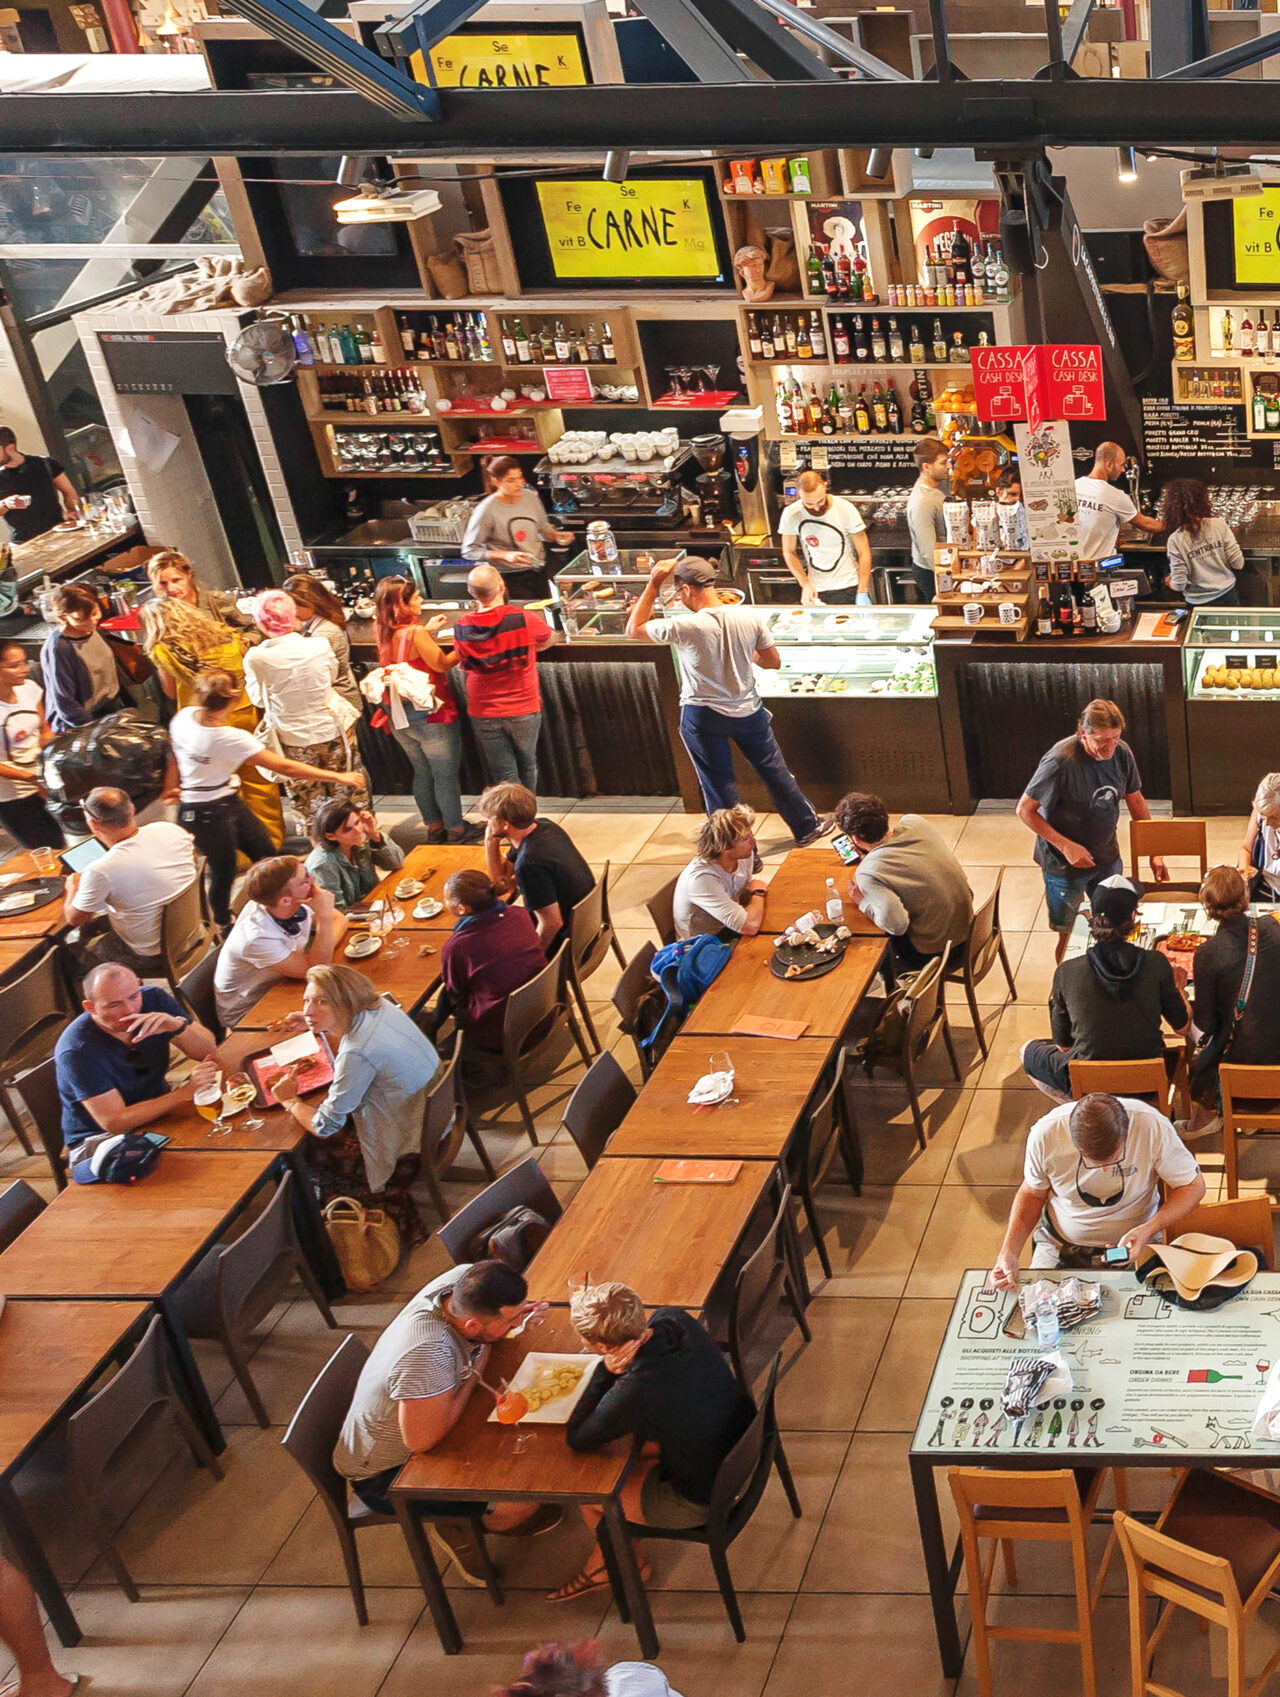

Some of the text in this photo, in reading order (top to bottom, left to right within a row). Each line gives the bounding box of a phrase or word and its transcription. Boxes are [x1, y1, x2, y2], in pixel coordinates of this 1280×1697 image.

[492, 41, 508, 52] Se
[437, 57, 453, 68] Fe
[557, 56, 564, 66] K
[460, 62, 551, 87] CARNE
[620, 186, 636, 197] Se
[566, 201, 582, 212] Fe
[683, 199, 691, 210] K
[1259, 207, 1274, 218] Fe
[587, 206, 678, 252] CARNE
[559, 236, 586, 247] vit B
[684, 238, 704, 250] Mg
[1245, 242, 1272, 253] vit B
[978, 351, 1024, 370] CASSA
[1052, 350, 1098, 368] CASSA
[980, 371, 1001, 383] CASH
[1053, 369, 1098, 382] CASH DESK
[918, 369, 928, 398] RTIN
[1078, 499, 1103, 512] TRALE
[1187, 541, 1222, 559] CENTRALE
